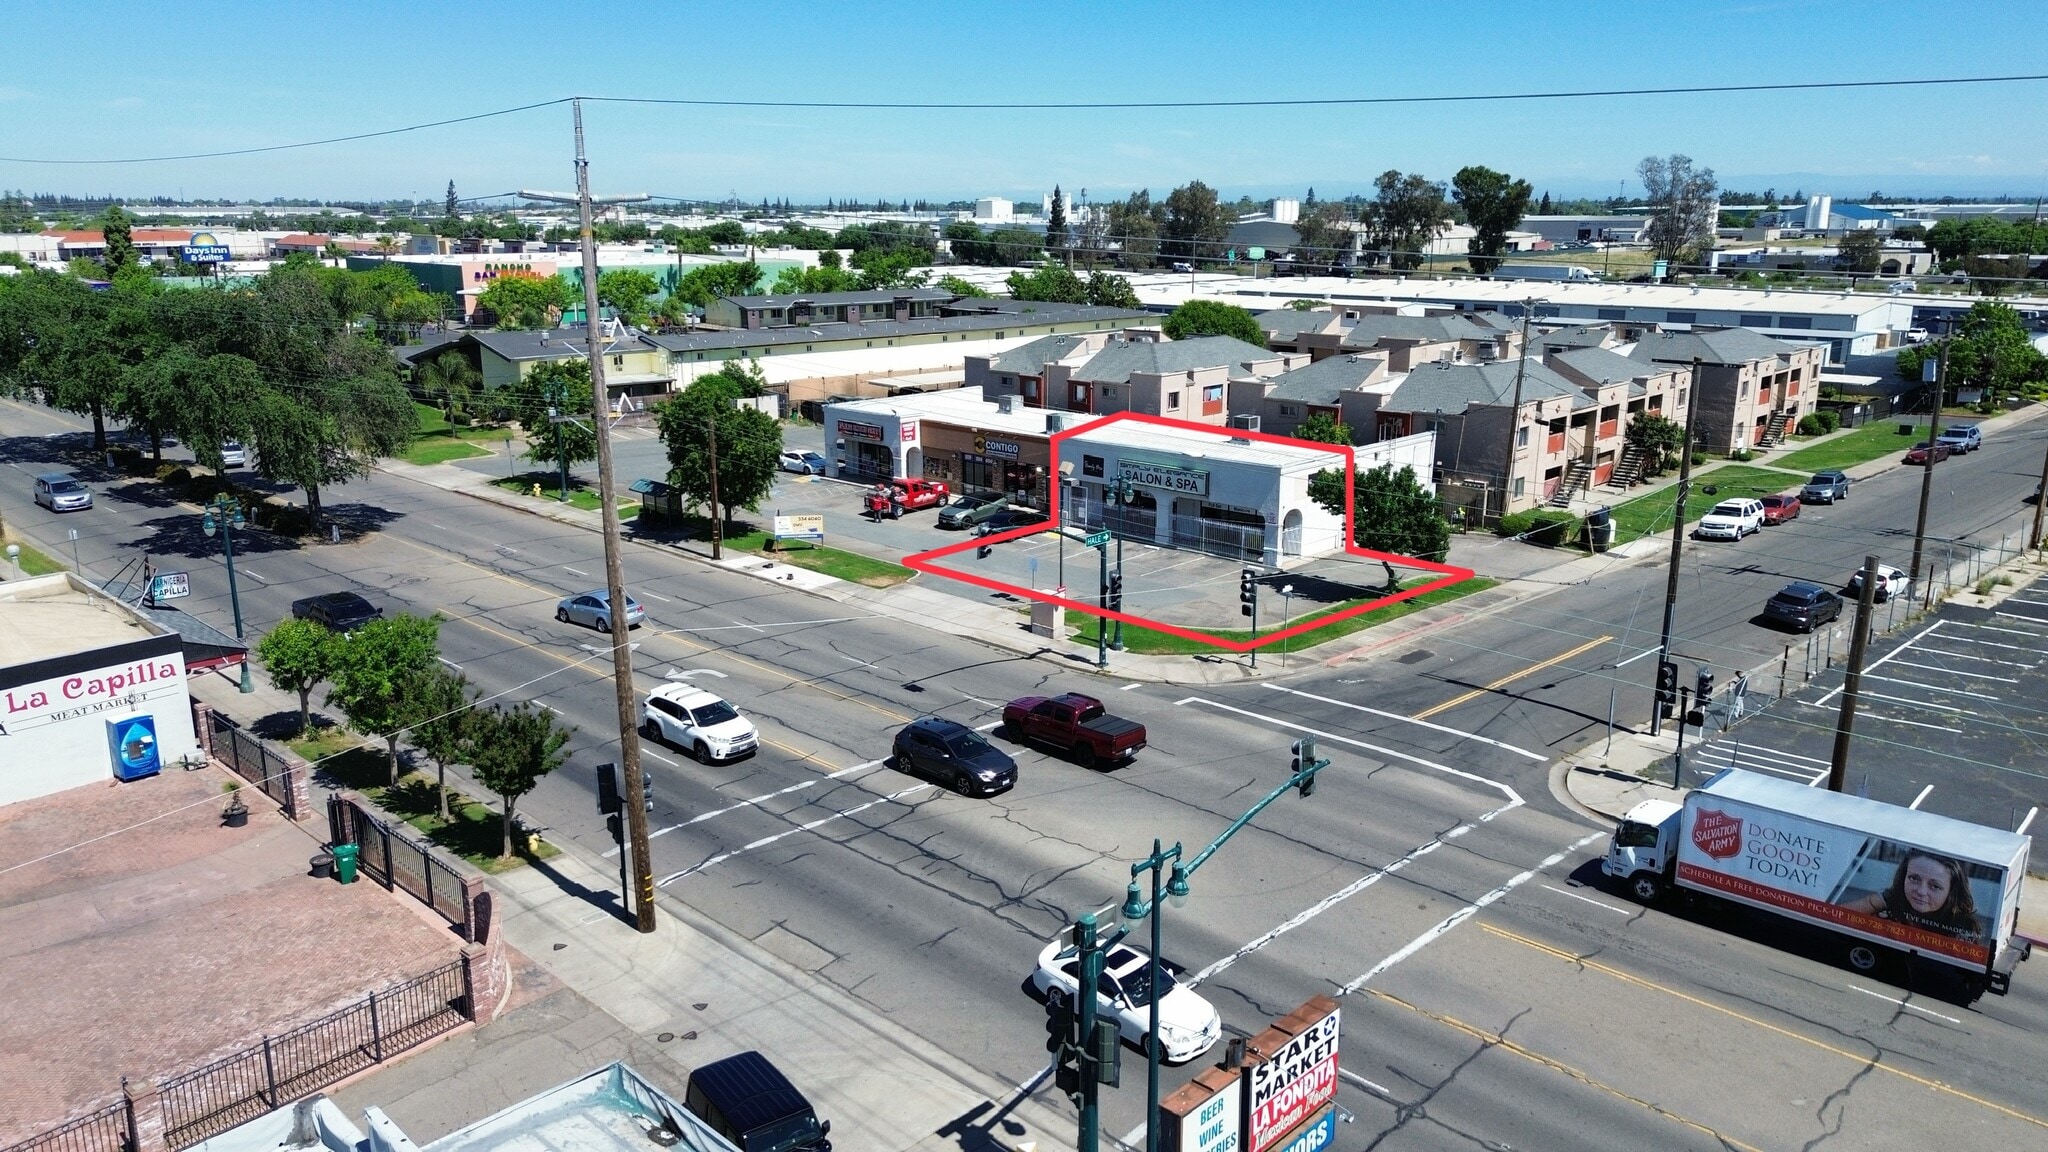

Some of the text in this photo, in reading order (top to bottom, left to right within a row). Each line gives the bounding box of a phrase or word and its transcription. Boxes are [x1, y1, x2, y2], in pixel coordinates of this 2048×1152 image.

[485, 263, 532, 271] RANCHO
[985, 441, 1019, 453] CONTIGO
[1120, 462, 1205, 480] SIMPLY ELEGANCE
[1125, 470, 1198, 492] SALON & SPA
[1088, 535, 1102, 545] HALE
[154, 586, 187, 597] CAPILLA
[5, 661, 177, 713] La Capilla
[50, 693, 148, 722] MEAT MARKET
[1695, 822, 1739, 842] SALVATION
[1703, 816, 1722, 828] THE
[1708, 836, 1736, 852] ARMY
[1749, 823, 1825, 854] DONATE
[1748, 840, 1821, 870] GOODS
[1746, 855, 1818, 888] TODAY!
[1680, 865, 1724, 884] SCHEDULE
[1725, 879, 1732, 887] A
[1733, 882, 1752, 893] FREE
[1755, 887, 1805, 907] DONATION
[1807, 902, 1844, 919] PICK-UP
[1914, 933, 1985, 958] SATRUCK.ORG
[1921, 918, 1940, 928] BEEN
[1941, 924, 1962, 935] MADE
[1255, 1026, 1320, 1085] STAR
[1255, 1036, 1335, 1109] MARKET
[1252, 1056, 1336, 1136] LA FONDITA
[1200, 1097, 1224, 1127] BEER
[1254, 1077, 1334, 1151] Mexican Food
[1199, 1119, 1224, 1148] WINE
[1285, 1120, 1328, 1152] ORS
